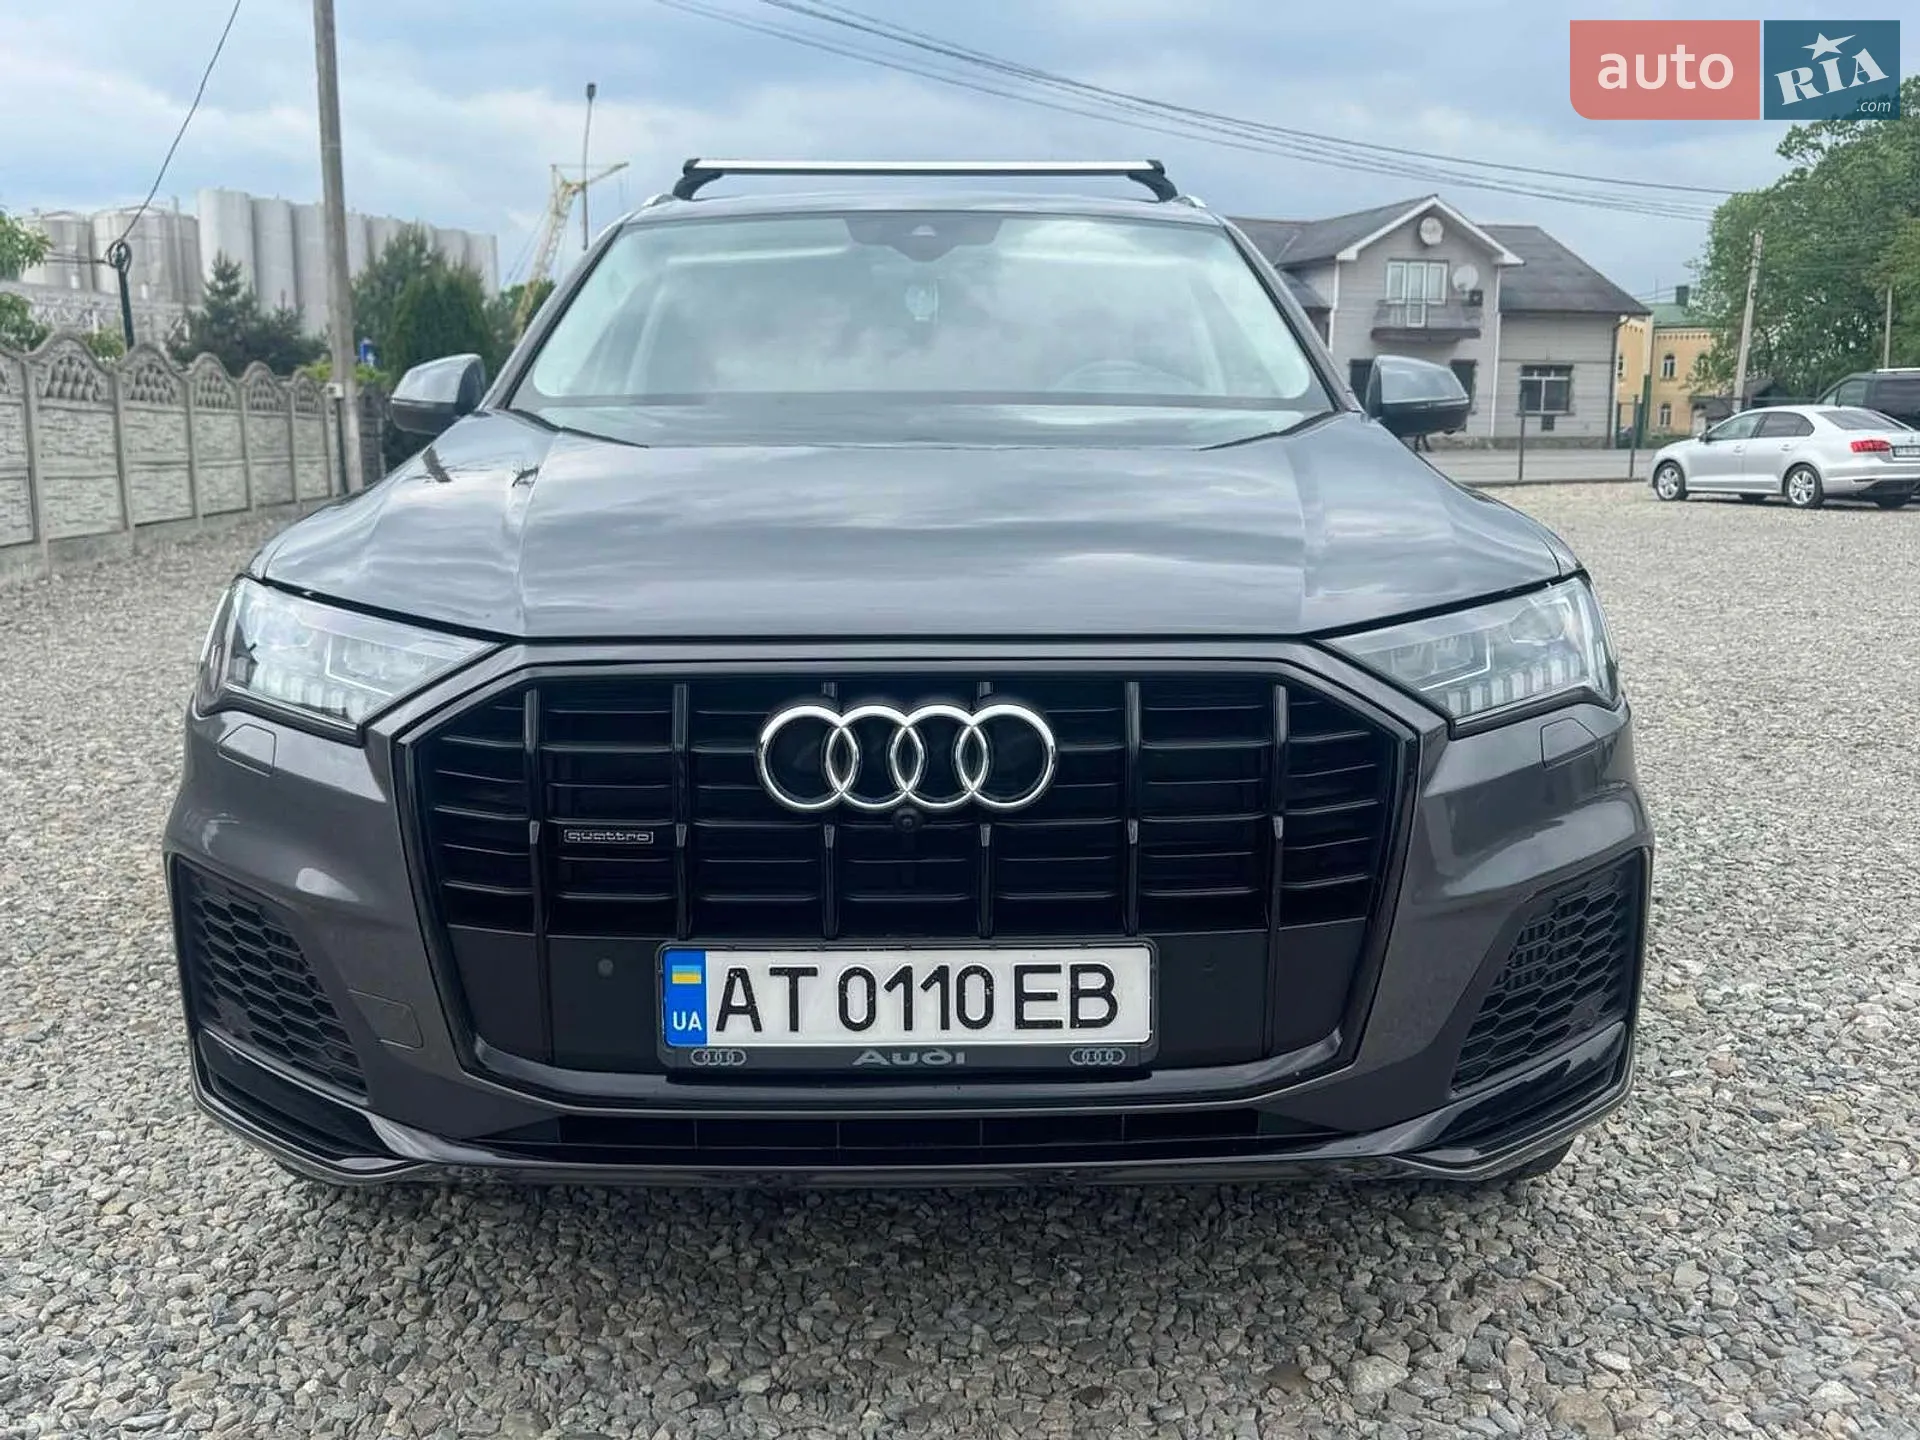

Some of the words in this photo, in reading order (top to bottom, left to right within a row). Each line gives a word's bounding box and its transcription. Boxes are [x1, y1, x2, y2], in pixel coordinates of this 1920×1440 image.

[567, 831, 650, 842] quattro
[715, 966, 819, 1033] AT
[837, 964, 994, 1032] 0110
[1013, 963, 1118, 1030] EB
[672, 1011, 703, 1031] UA
